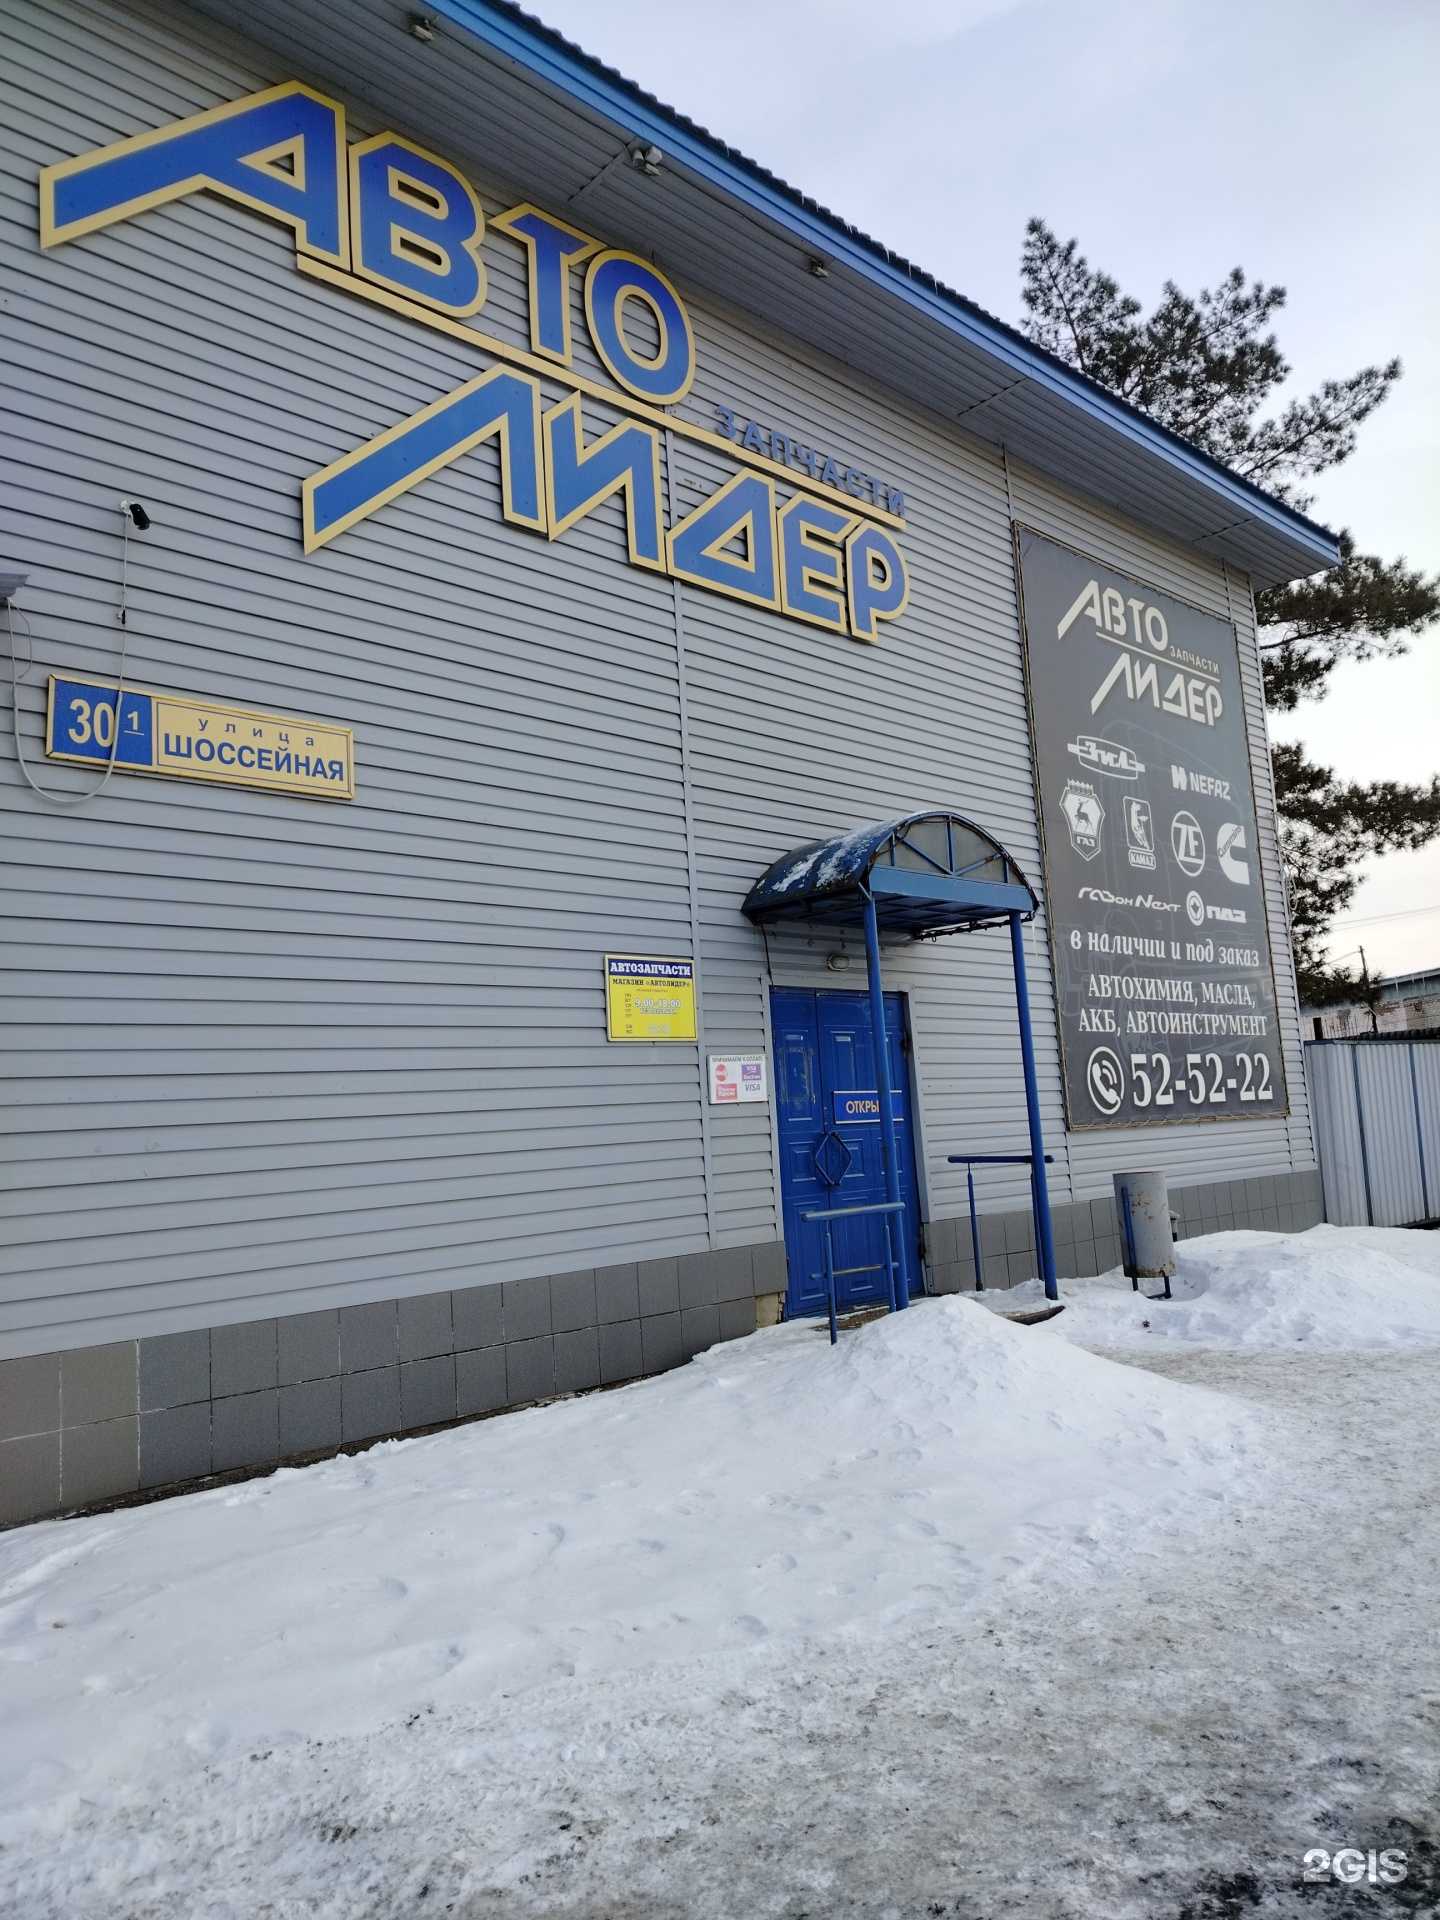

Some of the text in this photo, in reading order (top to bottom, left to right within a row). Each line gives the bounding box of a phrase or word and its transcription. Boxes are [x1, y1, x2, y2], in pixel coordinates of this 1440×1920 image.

[40, 79, 695, 405] АВТО
[714, 404, 906, 517] ЗАПЧАСТИ
[302, 363, 909, 643] ЛИДЕР
[1057, 579, 1169, 650] АВТО
[1170, 646, 1219, 674] ЗАПЧАСТИ
[1090, 652, 1223, 727] ЛИДЕР
[68, 698, 116, 748] 30
[198, 717, 315, 747] улица
[163, 732, 345, 782] ШОССЕЙНАЯ
[610, 962, 691, 976] АВТОЗАПЧАСТИ
[1070, 930, 1260, 968] в наличии и под заказ
[612, 978, 644, 986] МАГАЗИН
[1088, 974, 1257, 1009] АВТОХИМИЯ, МАСЛА,
[1078, 1008, 1268, 1037] АКБ, АВТОИНСТРУМЕНТ
[1130, 1052, 1274, 1107] 52-52-22
